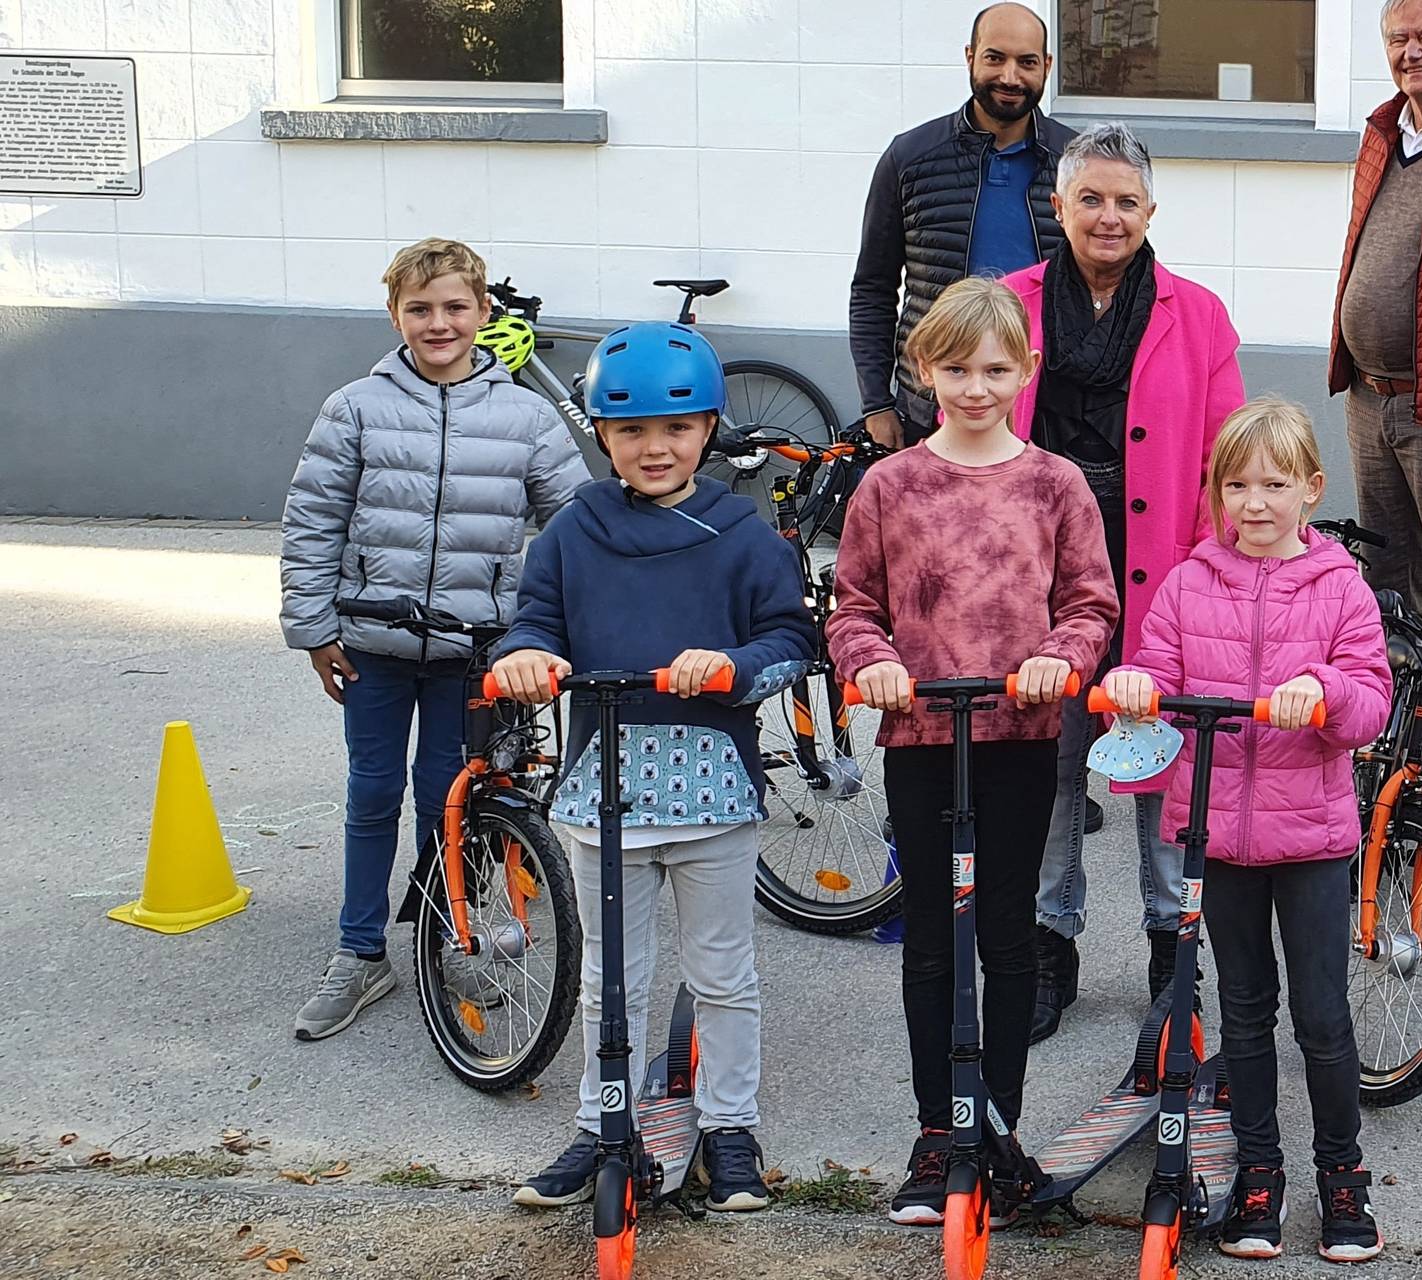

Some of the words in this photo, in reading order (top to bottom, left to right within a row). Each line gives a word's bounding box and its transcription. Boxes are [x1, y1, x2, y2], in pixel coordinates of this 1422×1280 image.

[961, 857, 973, 872] 7
[1180, 881, 1189, 908] MID
[1190, 882, 1201, 898] 7
